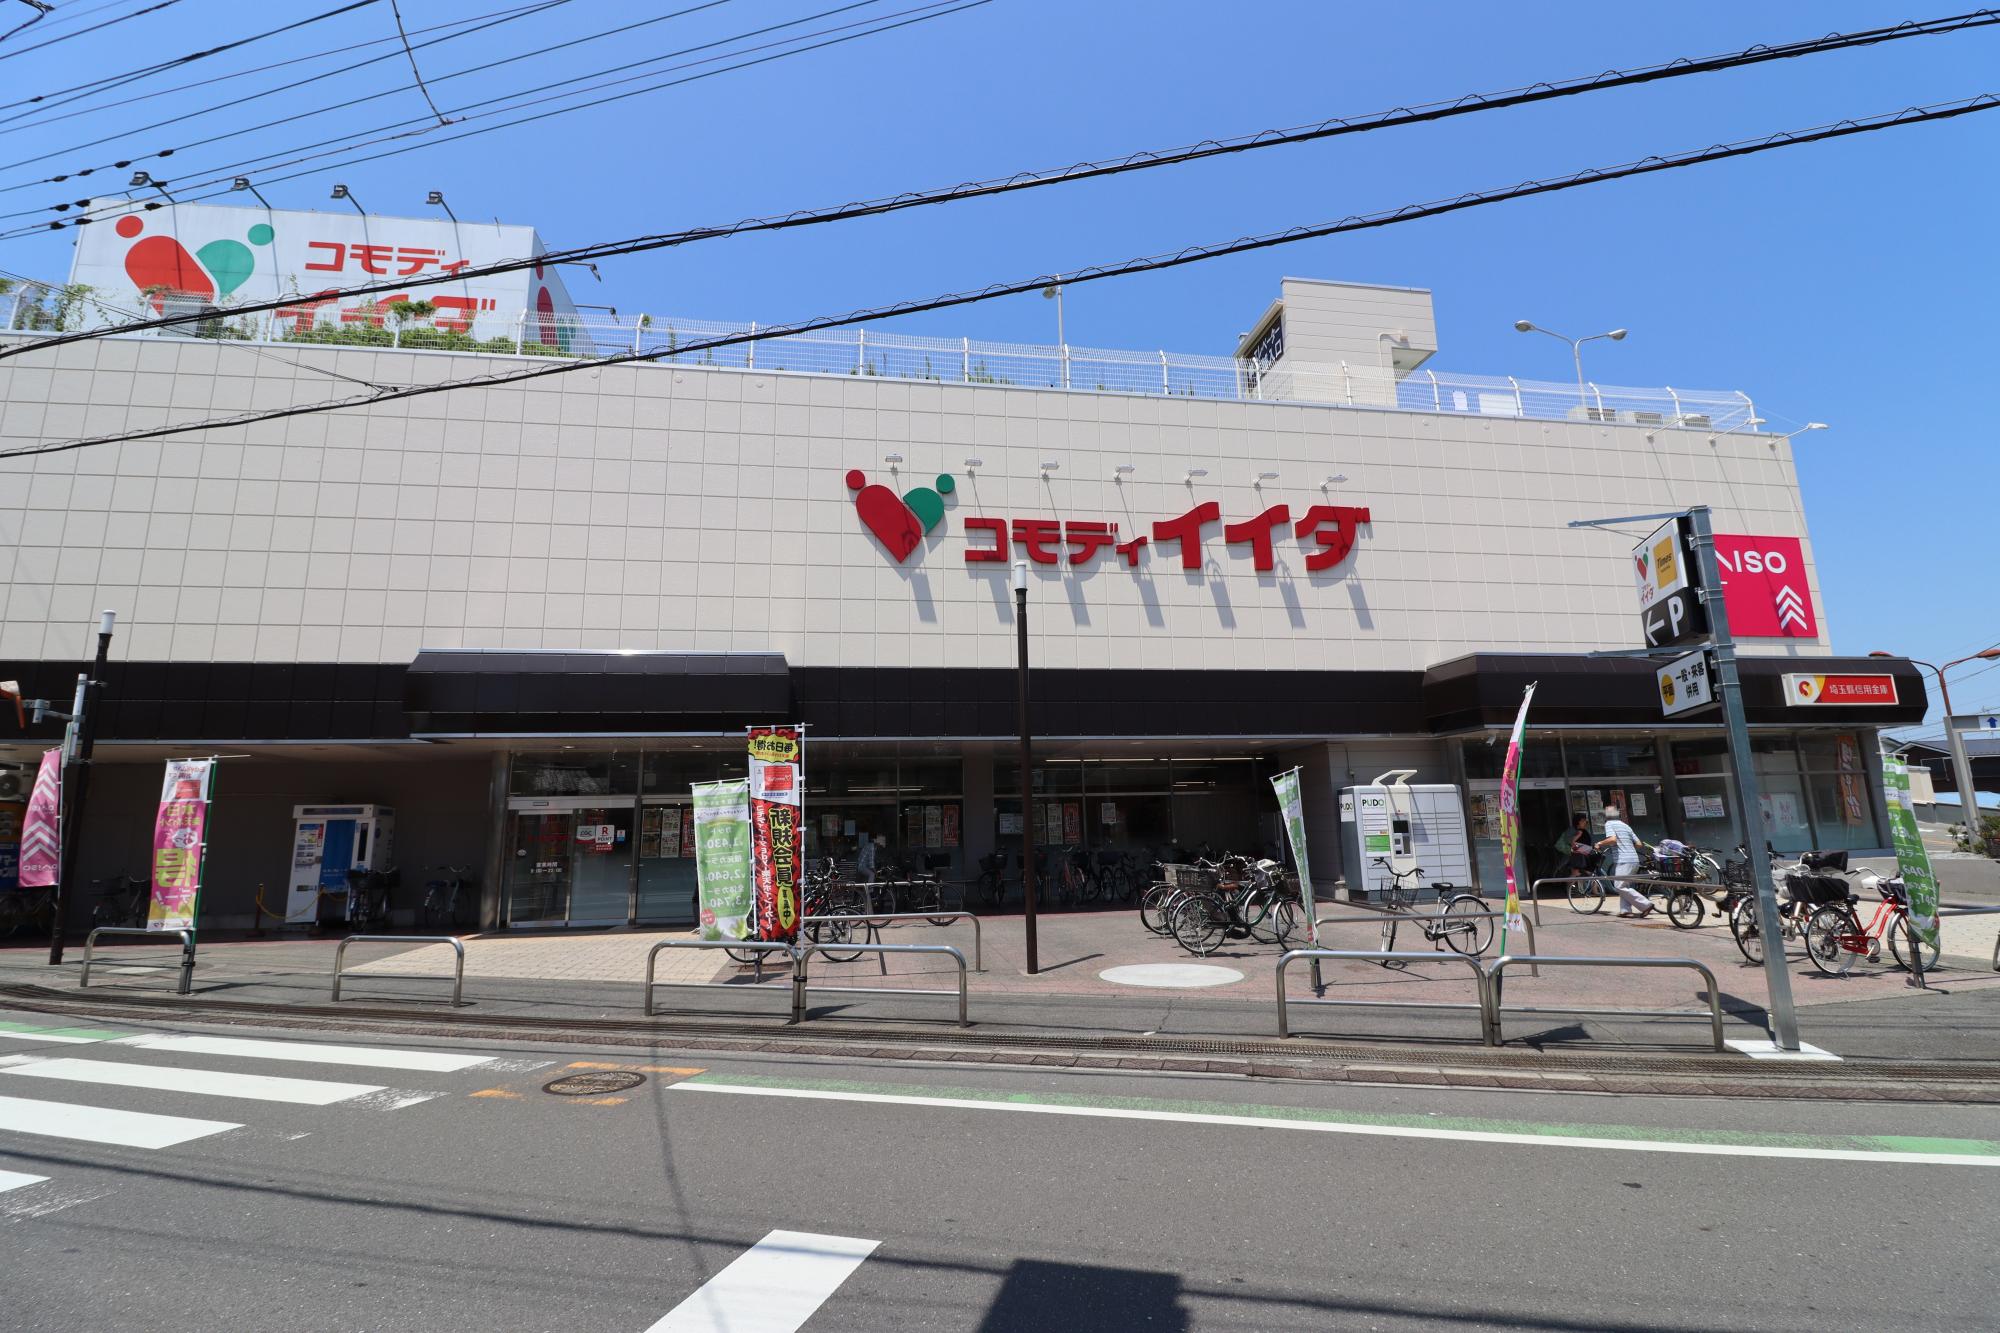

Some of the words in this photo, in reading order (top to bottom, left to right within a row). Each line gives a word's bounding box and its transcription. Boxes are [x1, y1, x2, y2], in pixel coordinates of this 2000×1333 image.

[305, 241, 470, 279] コモディ
[964, 501, 1371, 571] コモディイイダ
[1667, 595, 1684, 638] P
[1362, 798, 1385, 807] PUDO
